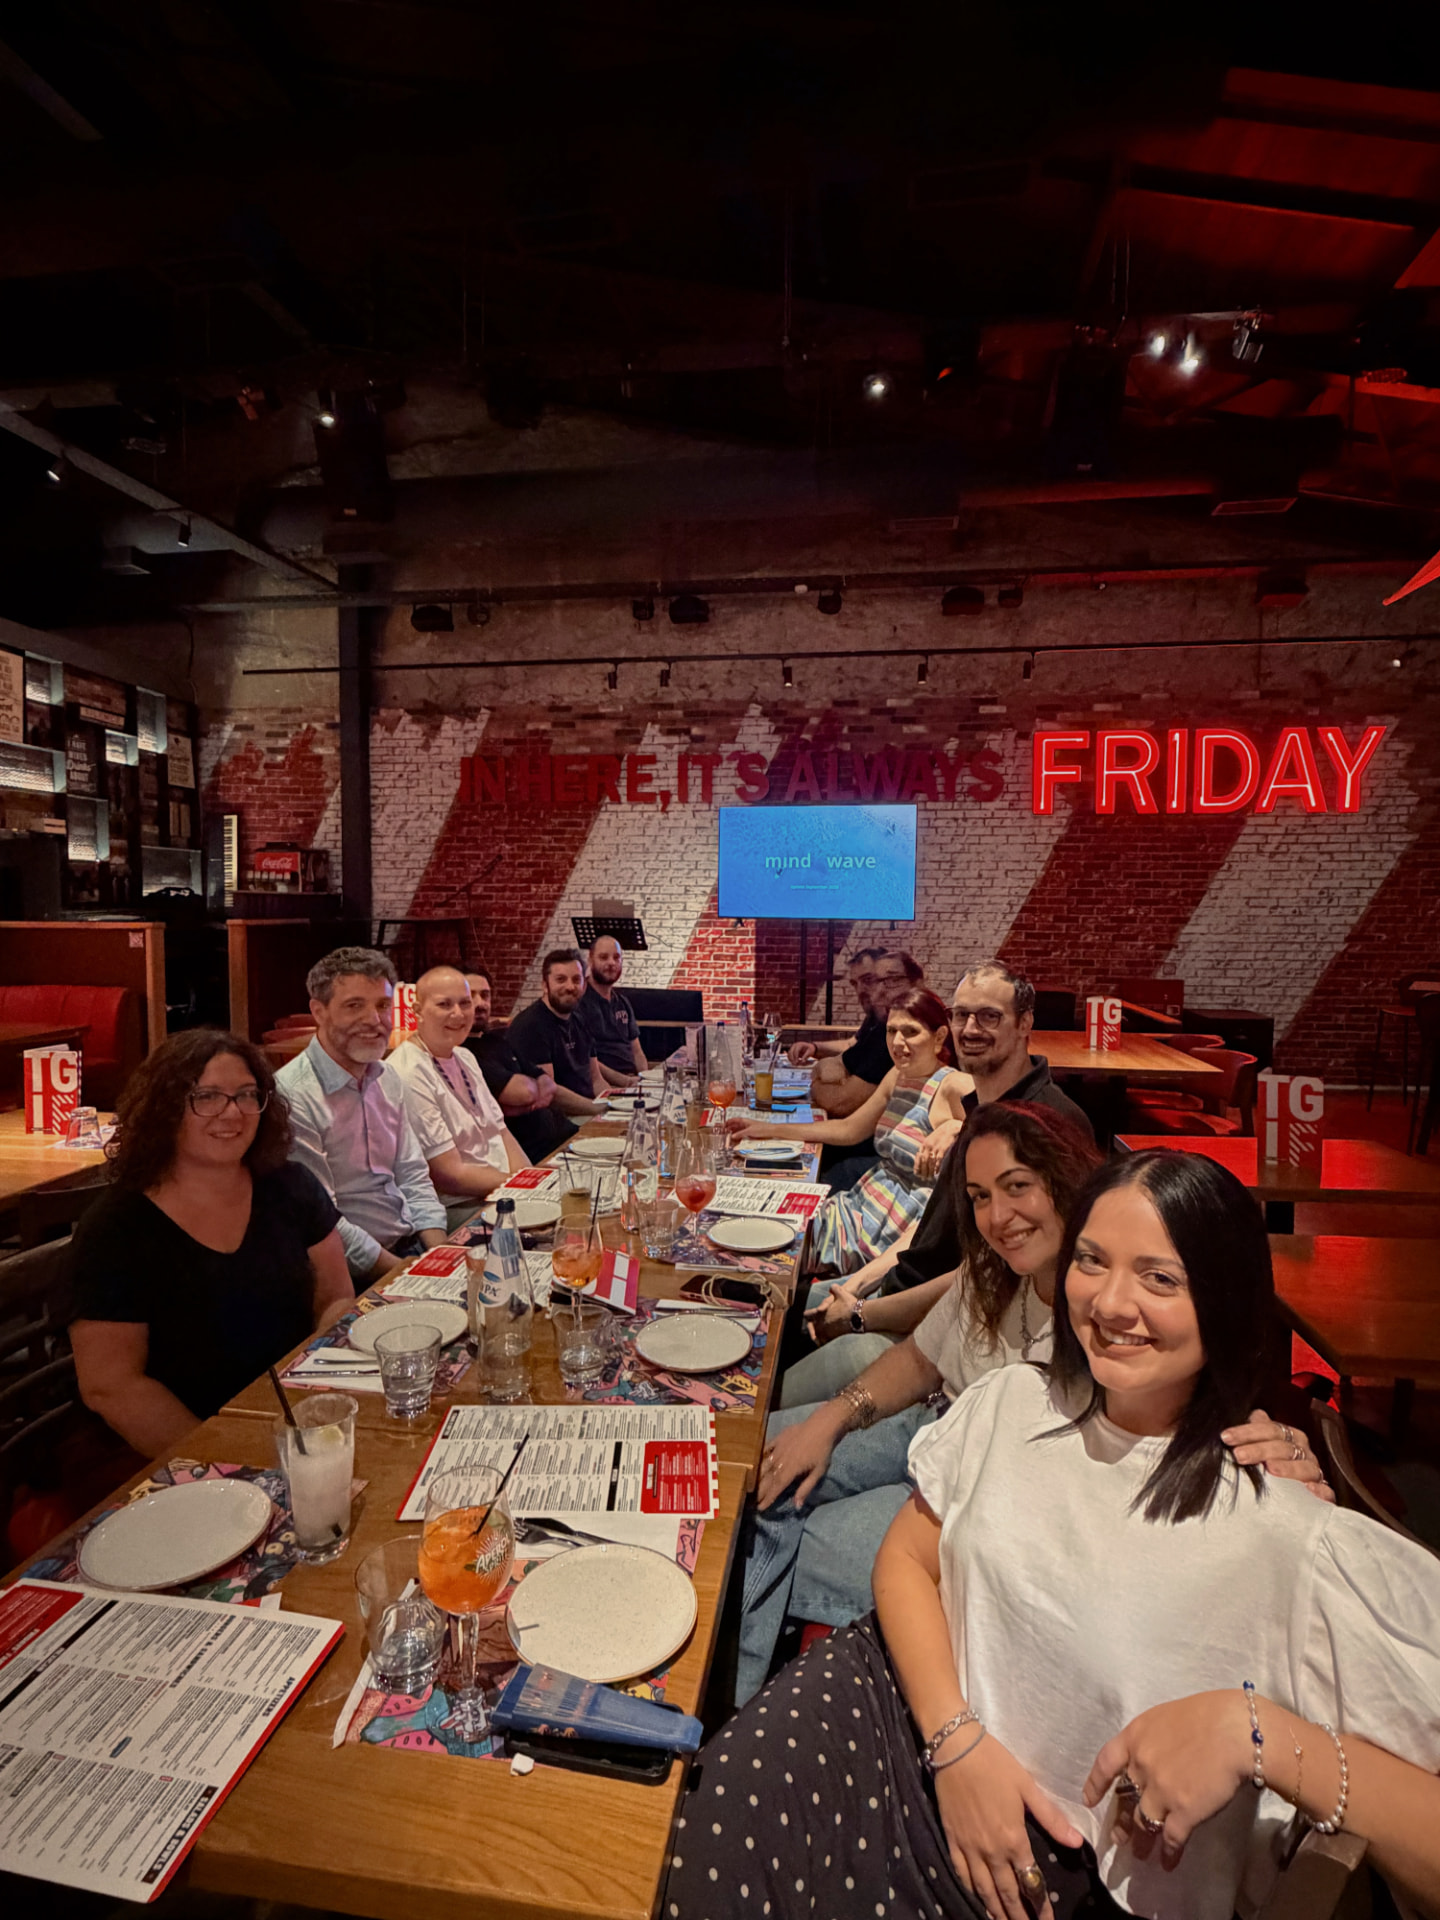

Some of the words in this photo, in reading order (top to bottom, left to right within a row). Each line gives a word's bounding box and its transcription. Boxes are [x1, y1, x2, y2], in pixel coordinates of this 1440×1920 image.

[460, 755, 505, 802] IN
[518, 752, 672, 812] HERE,
[678, 752, 770, 805] IT'S
[785, 749, 1004, 802] ALWAYS
[1033, 726, 1387, 815] FRIDAY
[765, 853, 811, 869] mind
[826, 855, 877, 869] wave
[1086, 996, 1122, 1025] TG
[23, 1050, 78, 1094] TG
[1258, 1073, 1324, 1122] TG
[261, 1676, 295, 1717] APPETIZERS
[180, 1796, 209, 1828] SALADS
[151, 1838, 179, 1870] BOWLS
